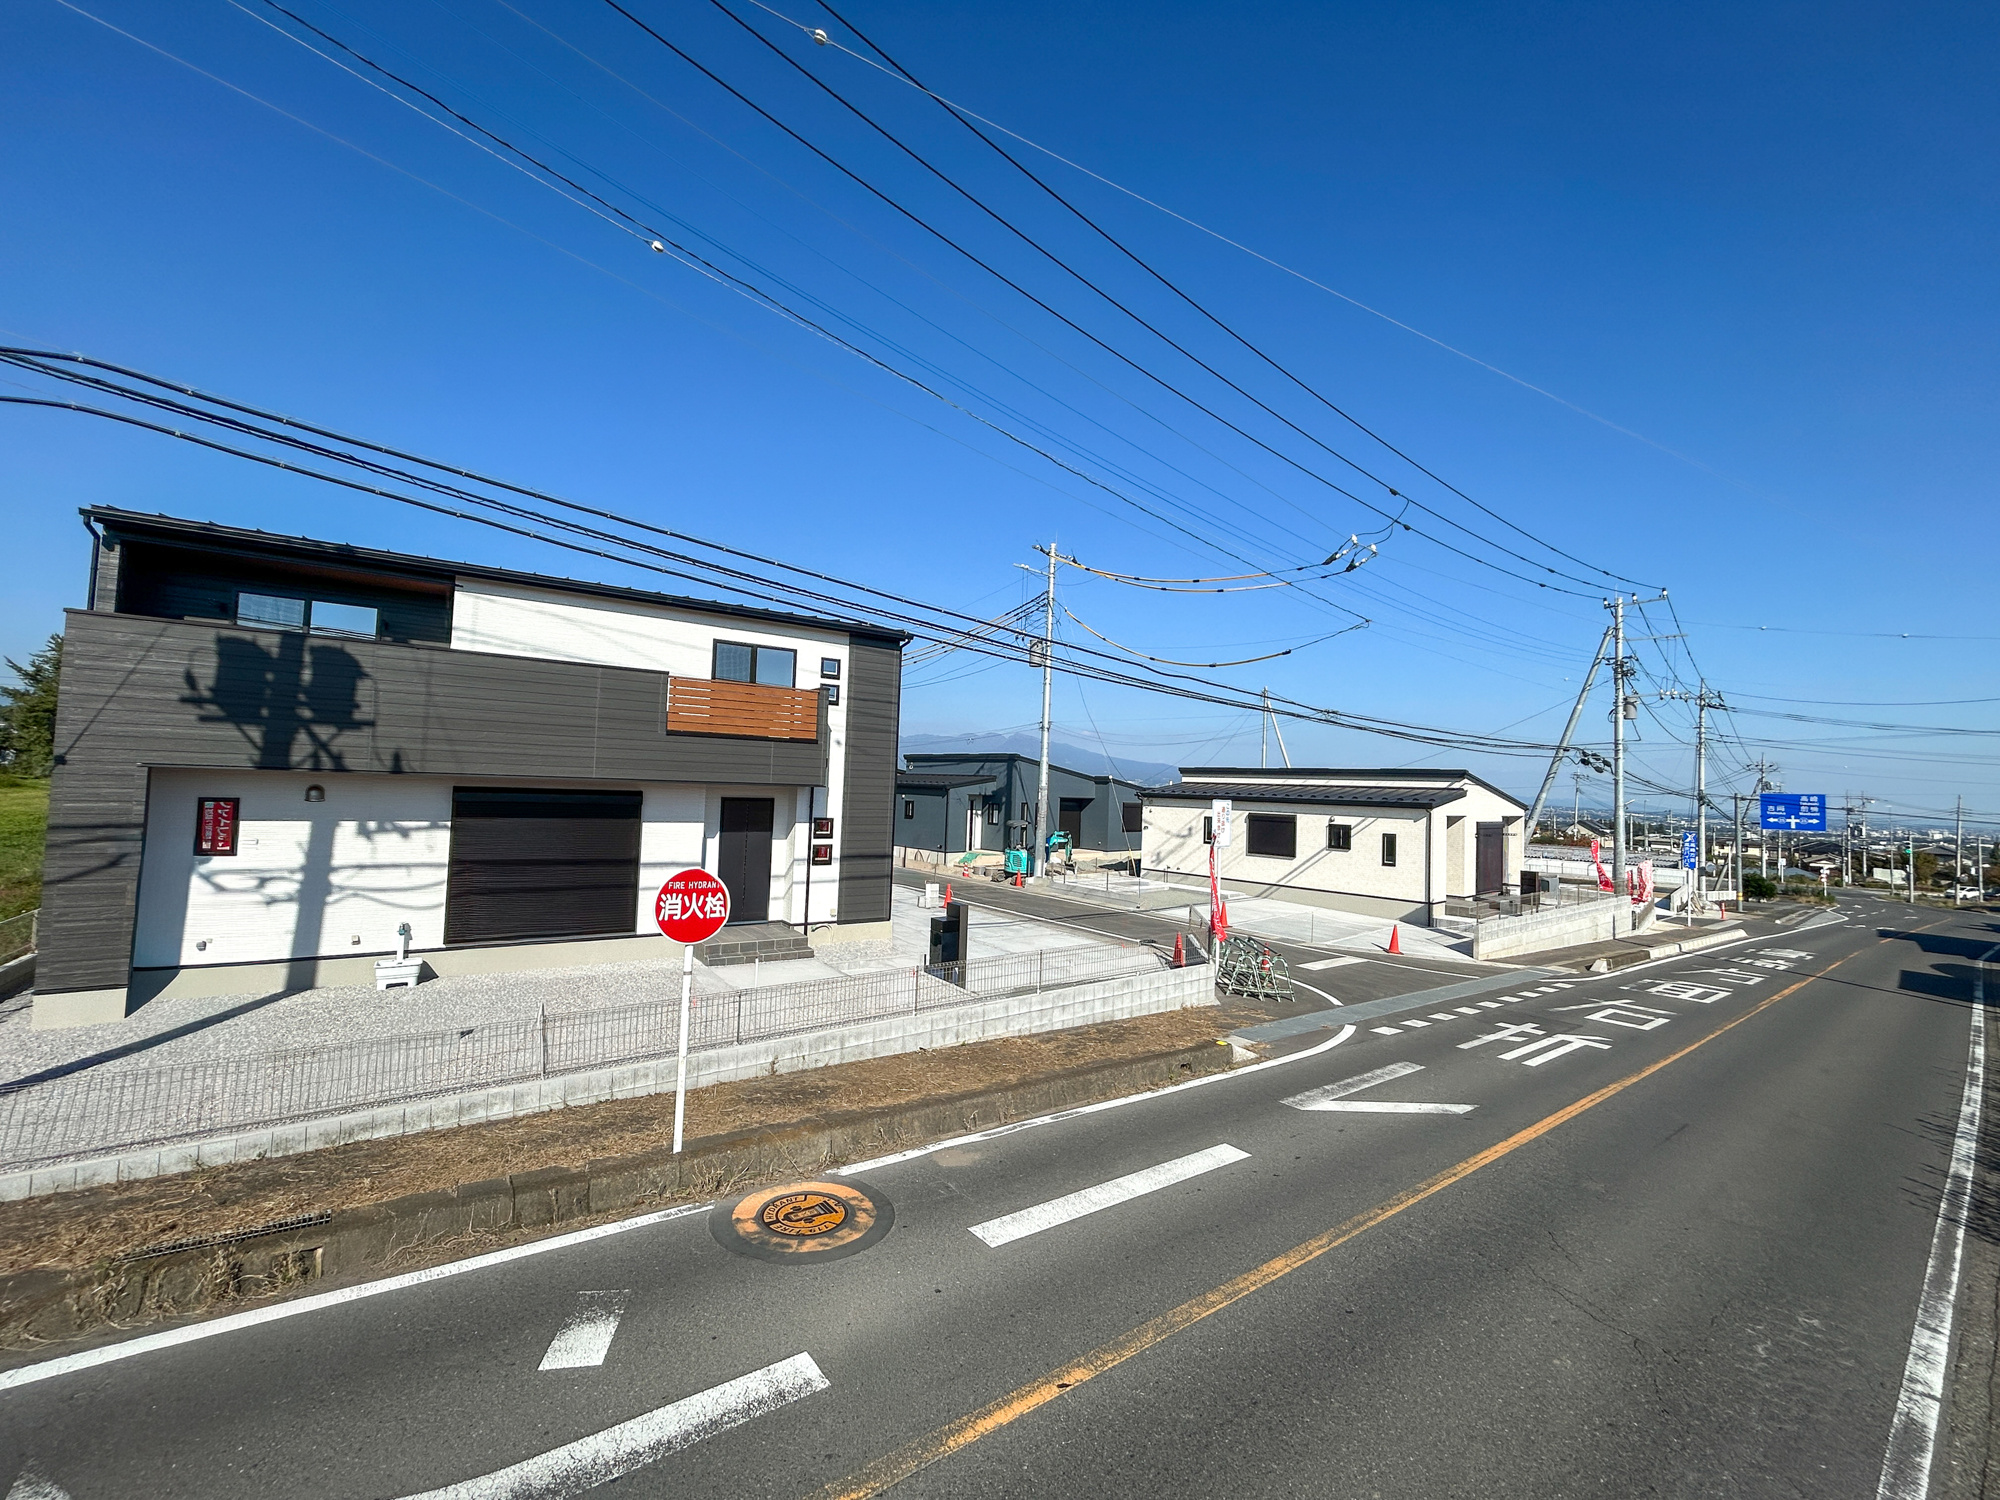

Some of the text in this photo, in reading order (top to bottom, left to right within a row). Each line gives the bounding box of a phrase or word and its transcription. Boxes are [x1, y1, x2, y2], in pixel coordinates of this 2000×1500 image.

[668, 881, 685, 889] FIRE
[659, 892, 725, 921] 消火栓
[765, 1196, 799, 1220] HYDRANT
